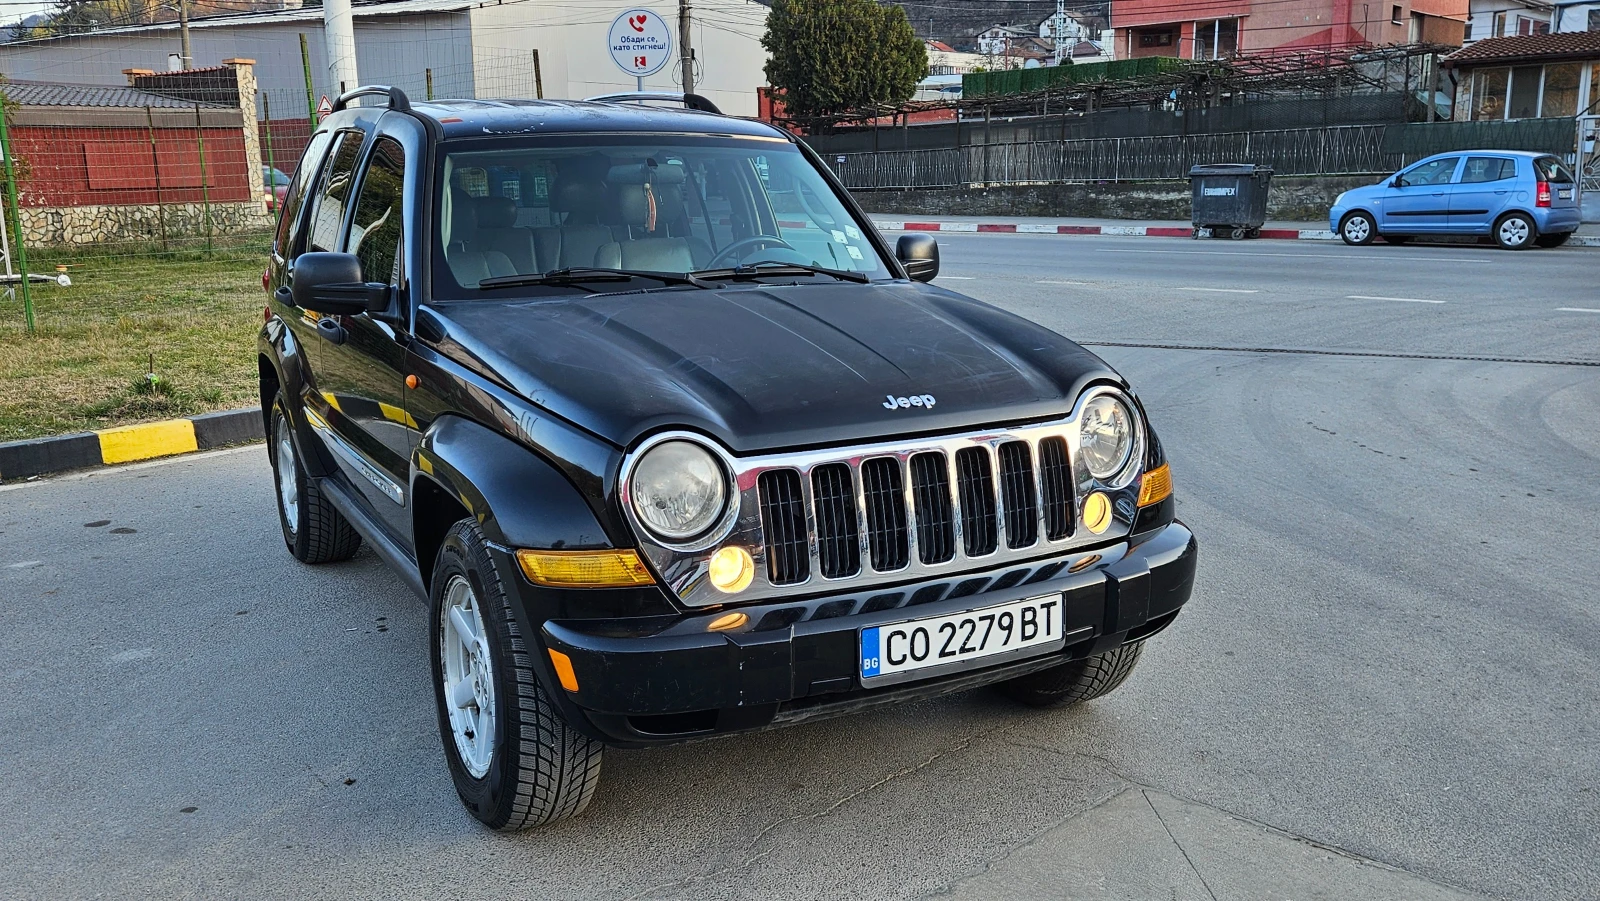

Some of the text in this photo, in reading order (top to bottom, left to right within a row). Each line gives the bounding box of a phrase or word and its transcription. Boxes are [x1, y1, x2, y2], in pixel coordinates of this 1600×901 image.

[882, 394, 936, 410] Jeep
[886, 601, 1057, 666] CO 2279 BT
[863, 658, 879, 670] BG
